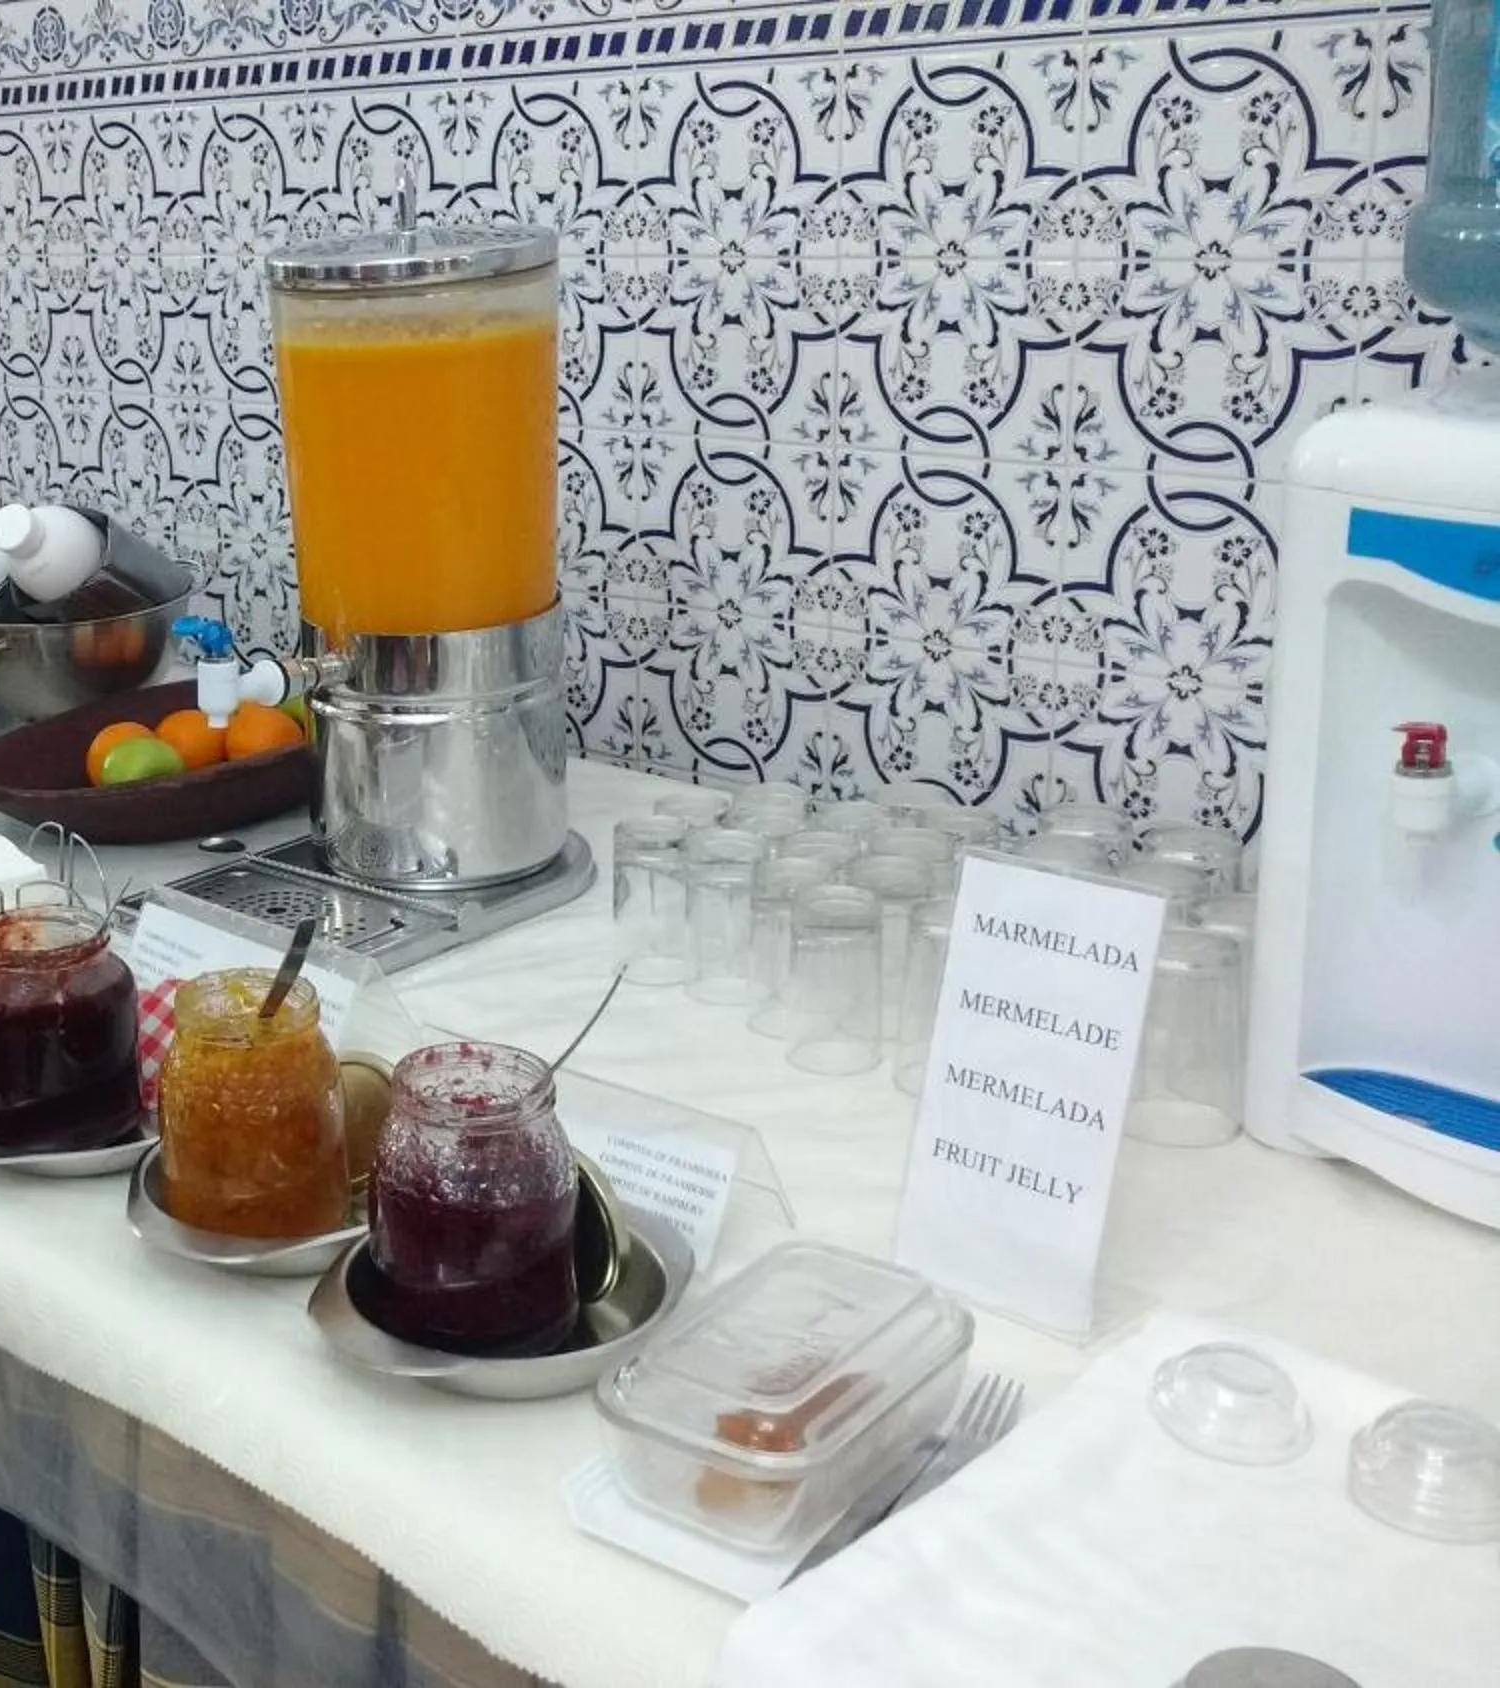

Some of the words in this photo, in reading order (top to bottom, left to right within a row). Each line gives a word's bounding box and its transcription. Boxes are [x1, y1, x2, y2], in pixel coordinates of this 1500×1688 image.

[972, 913, 1140, 973] MARMELADA
[959, 988, 1120, 1051] MERMELADE
[945, 1063, 1106, 1131] MERMELADA
[931, 1136, 1003, 1178] FRUIT
[1005, 1162, 1084, 1205] JELLY
